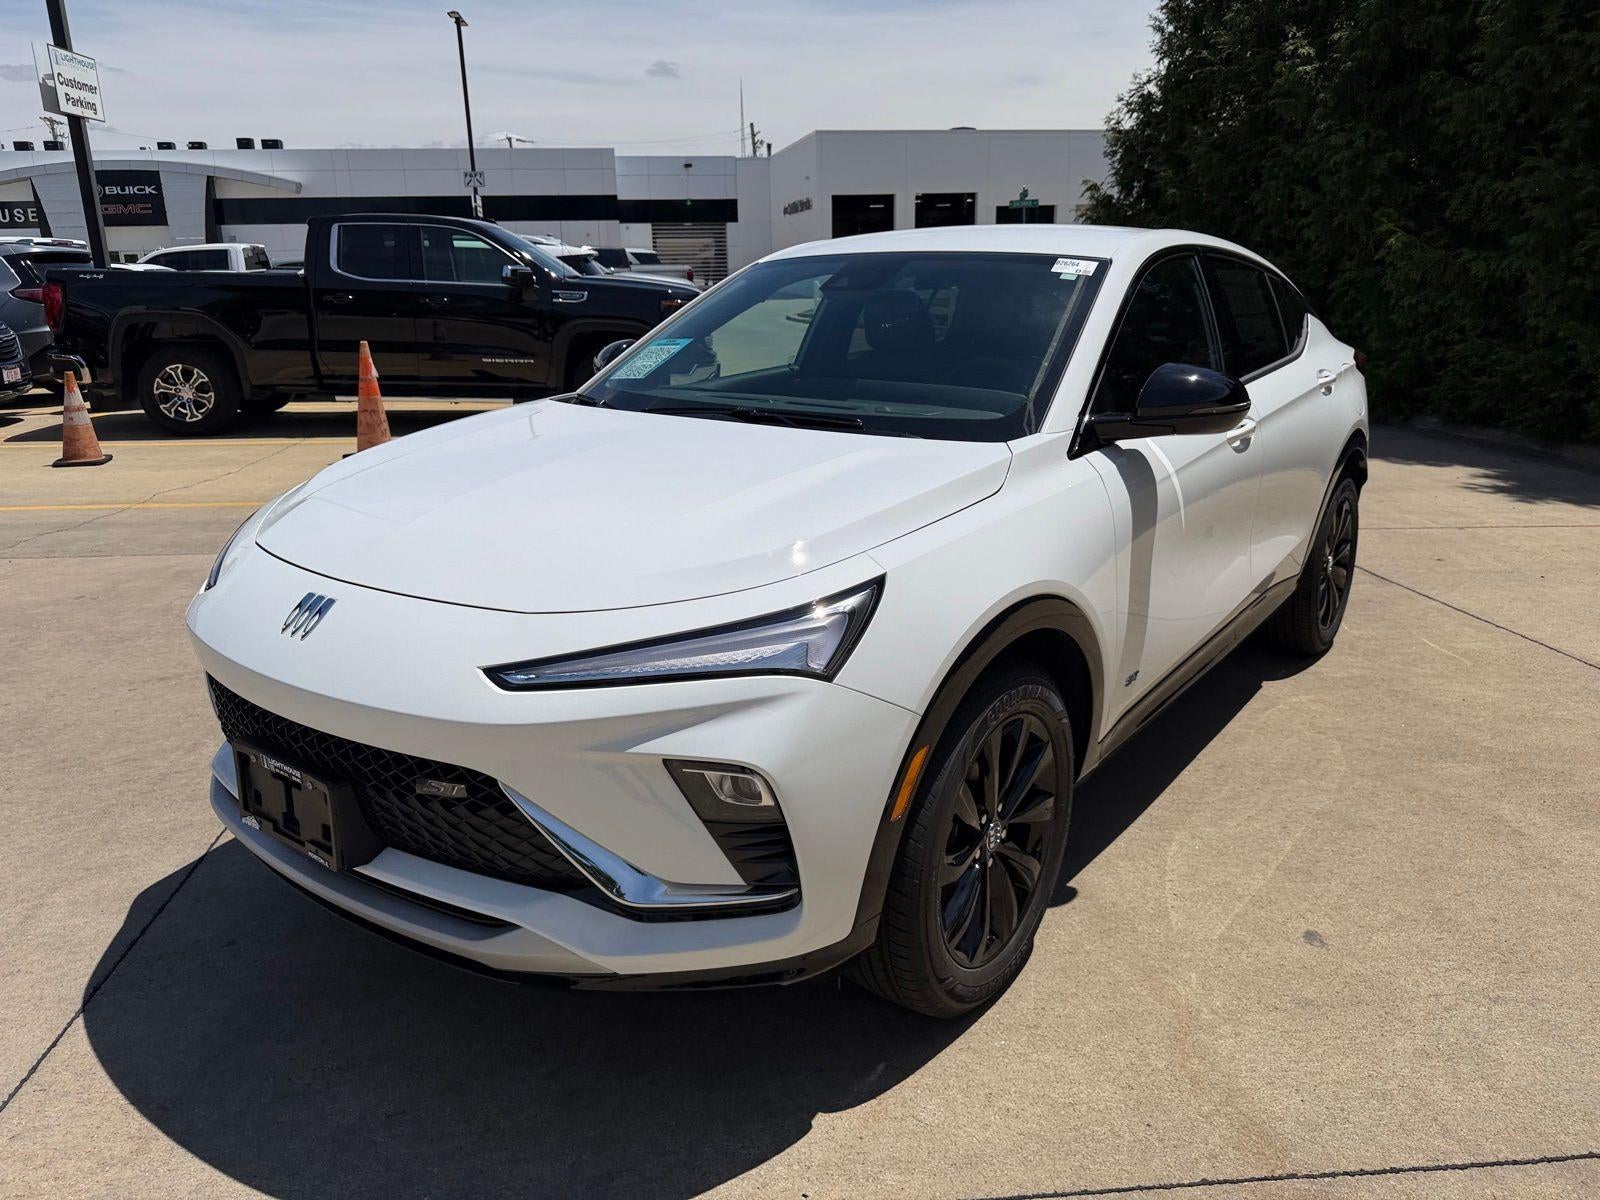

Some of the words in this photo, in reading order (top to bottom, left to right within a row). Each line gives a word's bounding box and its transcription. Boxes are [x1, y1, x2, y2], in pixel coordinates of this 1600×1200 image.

[60, 52, 95, 70] LIGHTHOUSE
[57, 72, 97, 94] Customer
[65, 92, 97, 115] Parking
[105, 185, 157, 194] BUICK
[0, 208, 38, 222] USE
[100, 203, 152, 214] GMC
[270, 758, 301, 778] LIGHTHOUSE
